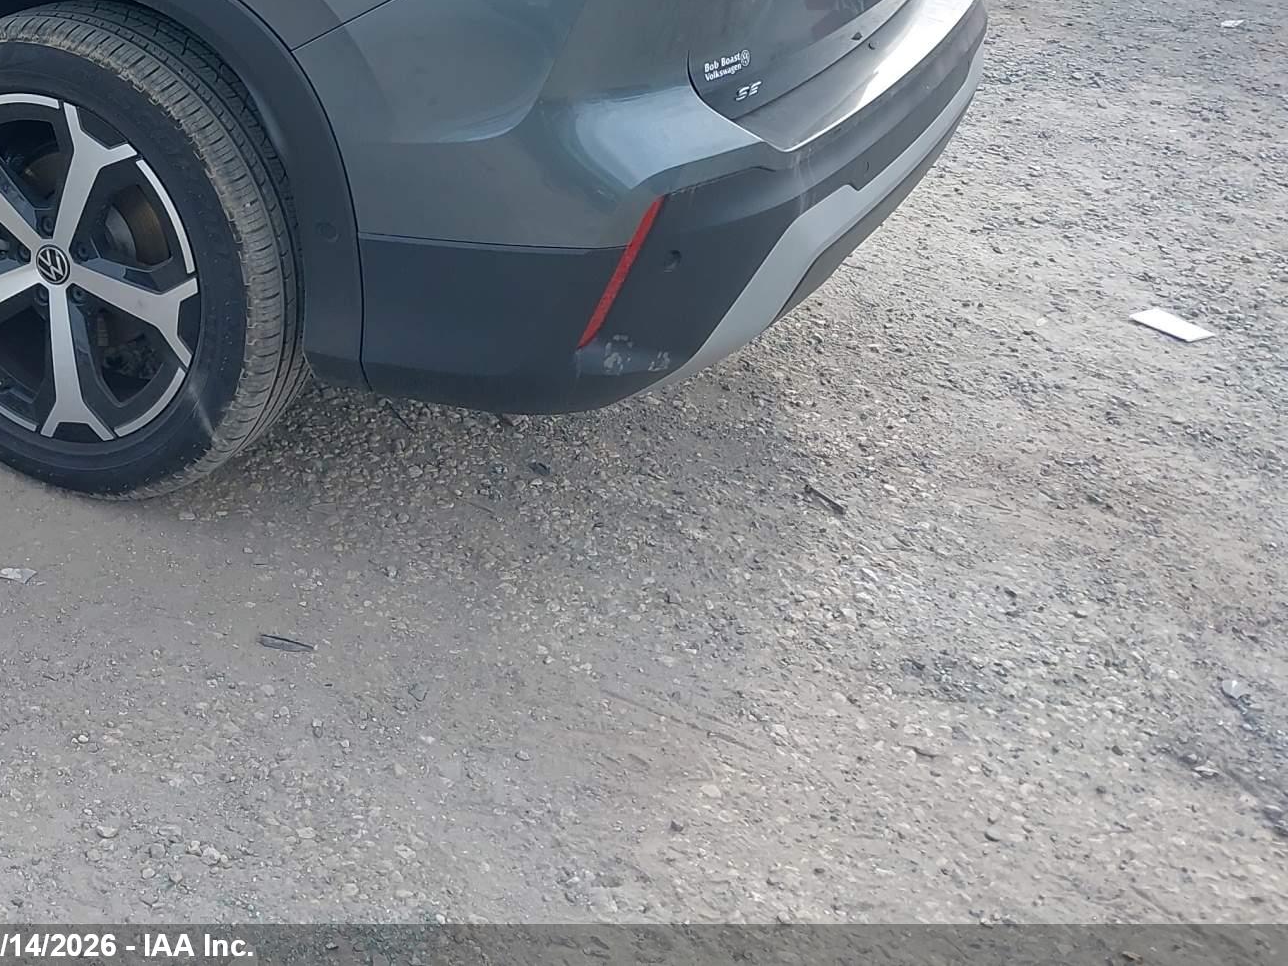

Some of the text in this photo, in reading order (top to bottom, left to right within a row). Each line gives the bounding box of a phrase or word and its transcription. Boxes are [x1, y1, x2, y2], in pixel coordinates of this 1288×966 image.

[704, 60, 720, 73] Bob
[720, 52, 741, 67] Boast
[704, 62, 742, 81] Volkswagen
[735, 80, 762, 102] SE
